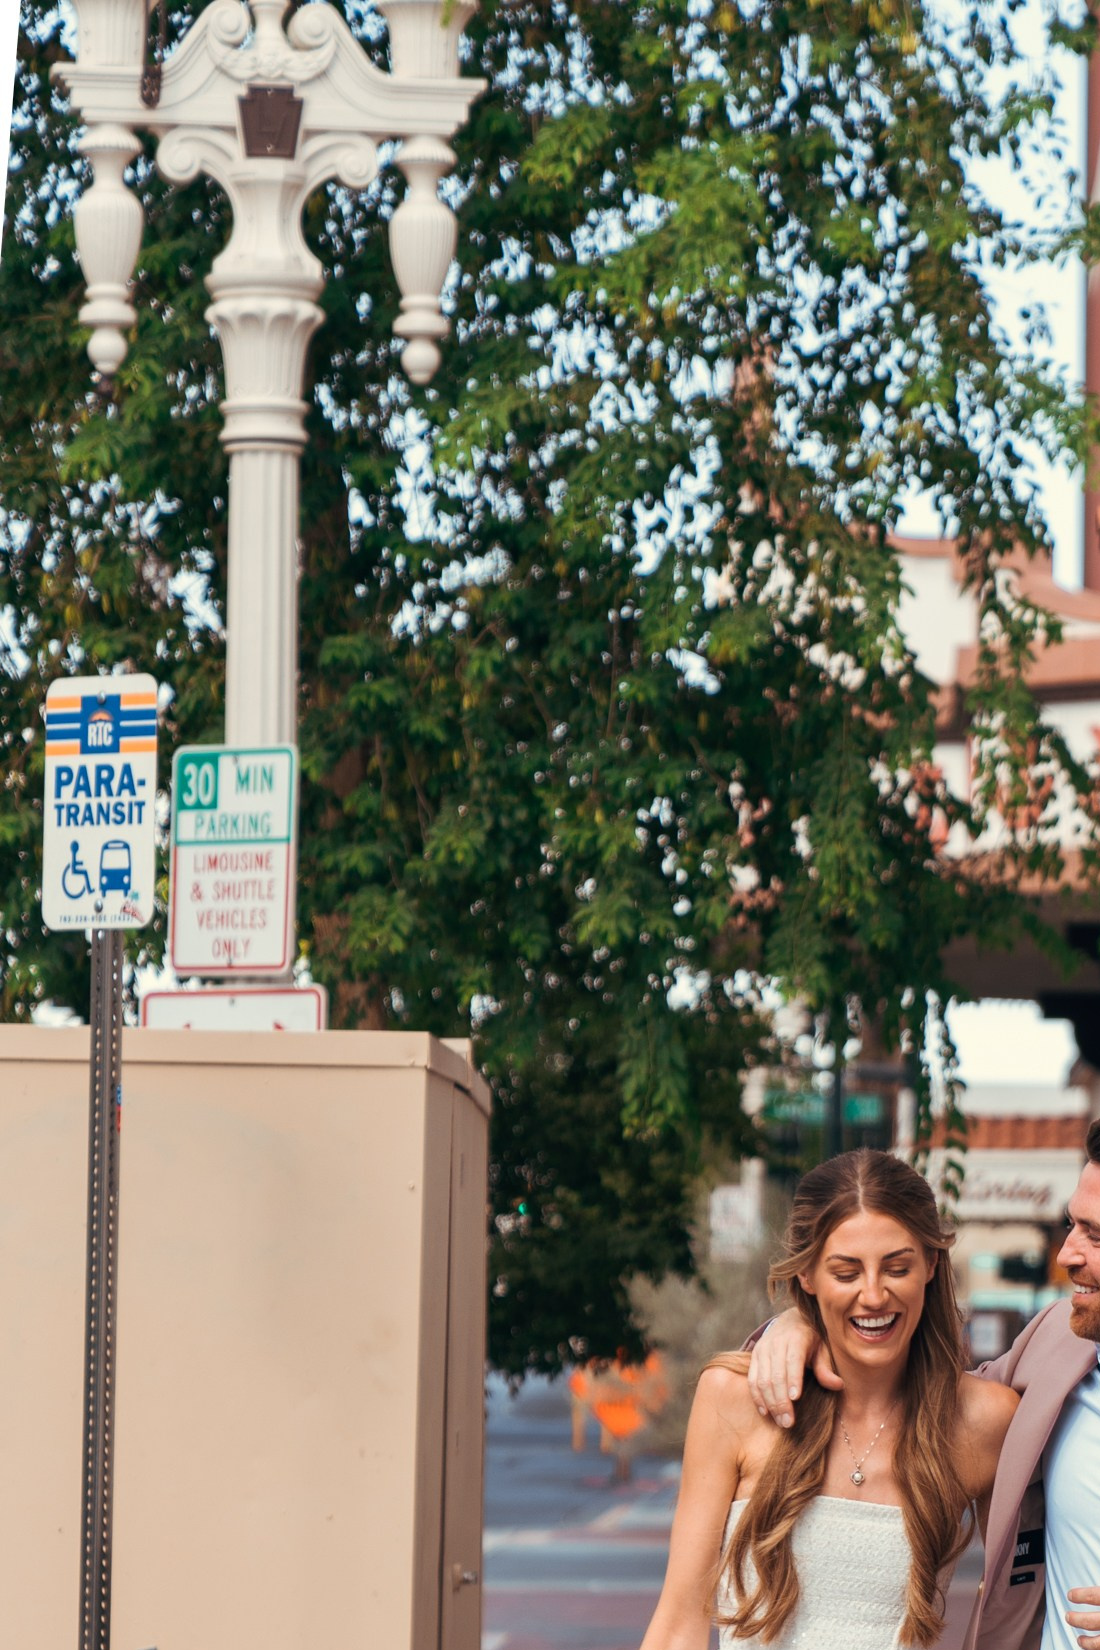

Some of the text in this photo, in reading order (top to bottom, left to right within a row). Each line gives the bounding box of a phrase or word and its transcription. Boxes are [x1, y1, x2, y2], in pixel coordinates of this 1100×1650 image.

[87, 721, 113, 748] RTC
[54, 763, 146, 799] PARA-
[183, 762, 274, 806] 30 MIN
[54, 801, 146, 827] TRANSIT
[194, 811, 271, 840] PARKING
[193, 850, 273, 874] LIMOUSINE
[190, 878, 275, 902] & SHUTTLE
[196, 907, 267, 930] VEHICLES
[211, 937, 251, 959] ONLY
